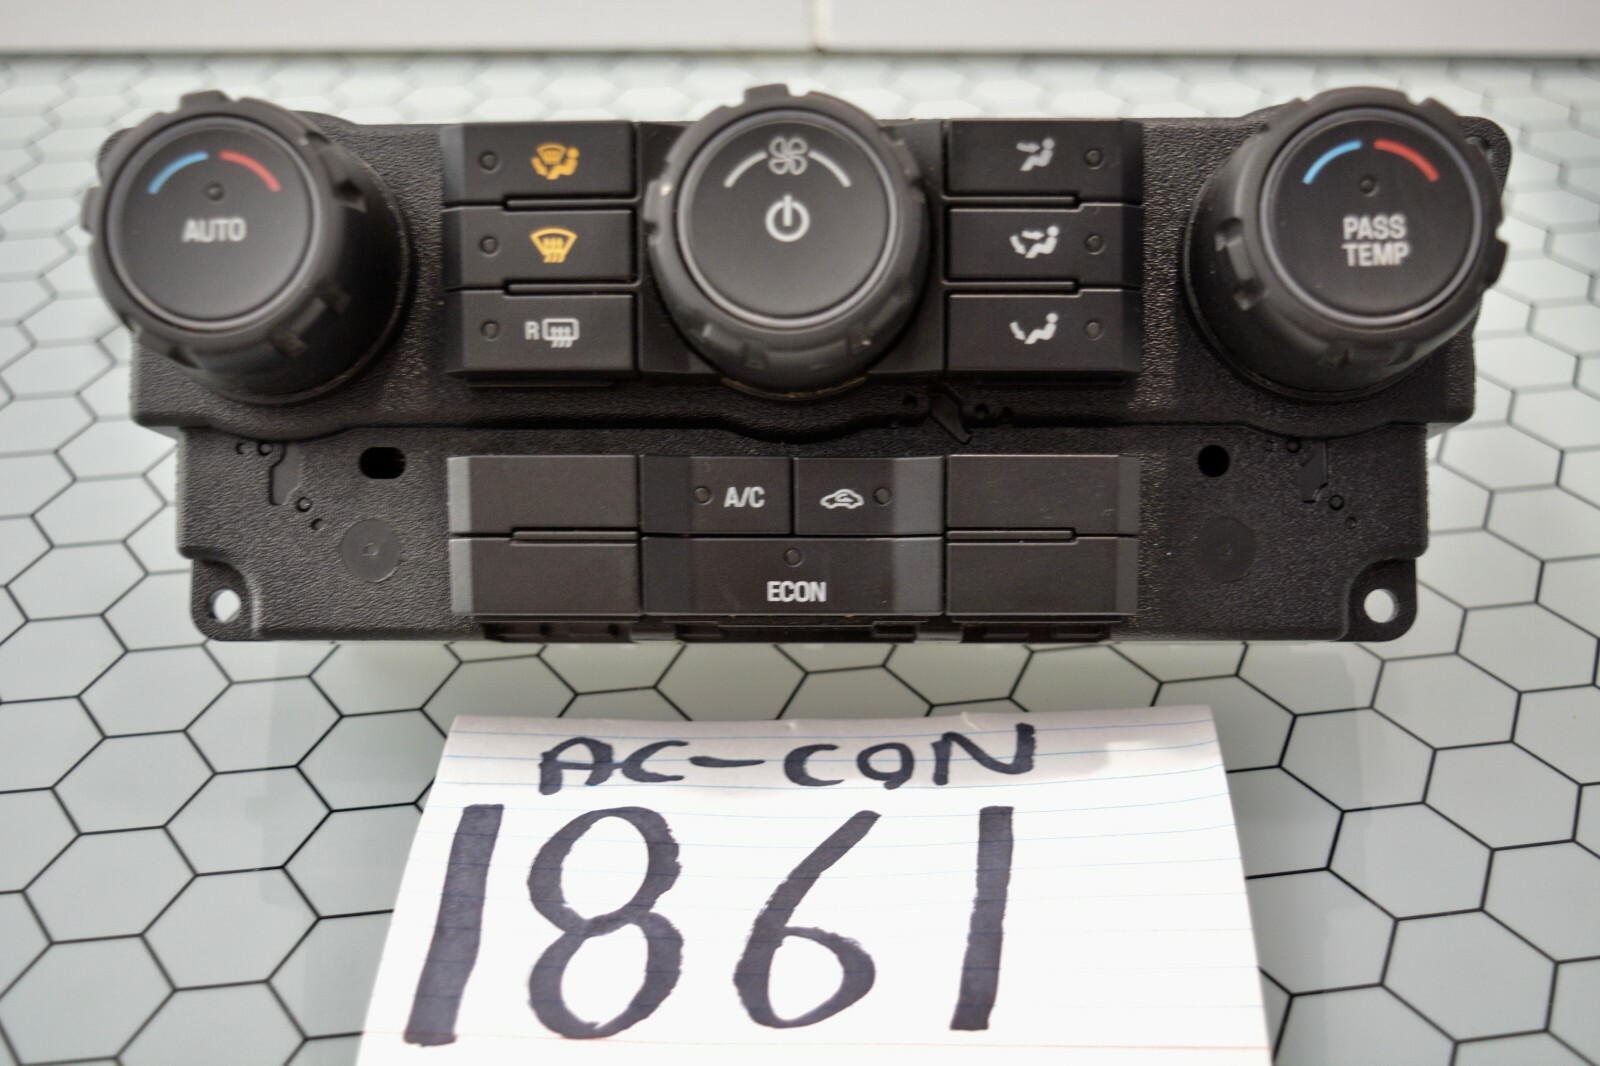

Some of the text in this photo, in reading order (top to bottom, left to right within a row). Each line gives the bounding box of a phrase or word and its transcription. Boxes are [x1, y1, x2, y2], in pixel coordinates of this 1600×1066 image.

[182, 217, 247, 243] AUTO
[1343, 214, 1407, 240] PASS
[1342, 241, 1410, 267] TEMP
[524, 320, 541, 340] R
[723, 486, 765, 509] A/C
[766, 580, 827, 603] ECON
[403, 804, 1015, 1046] 1861
